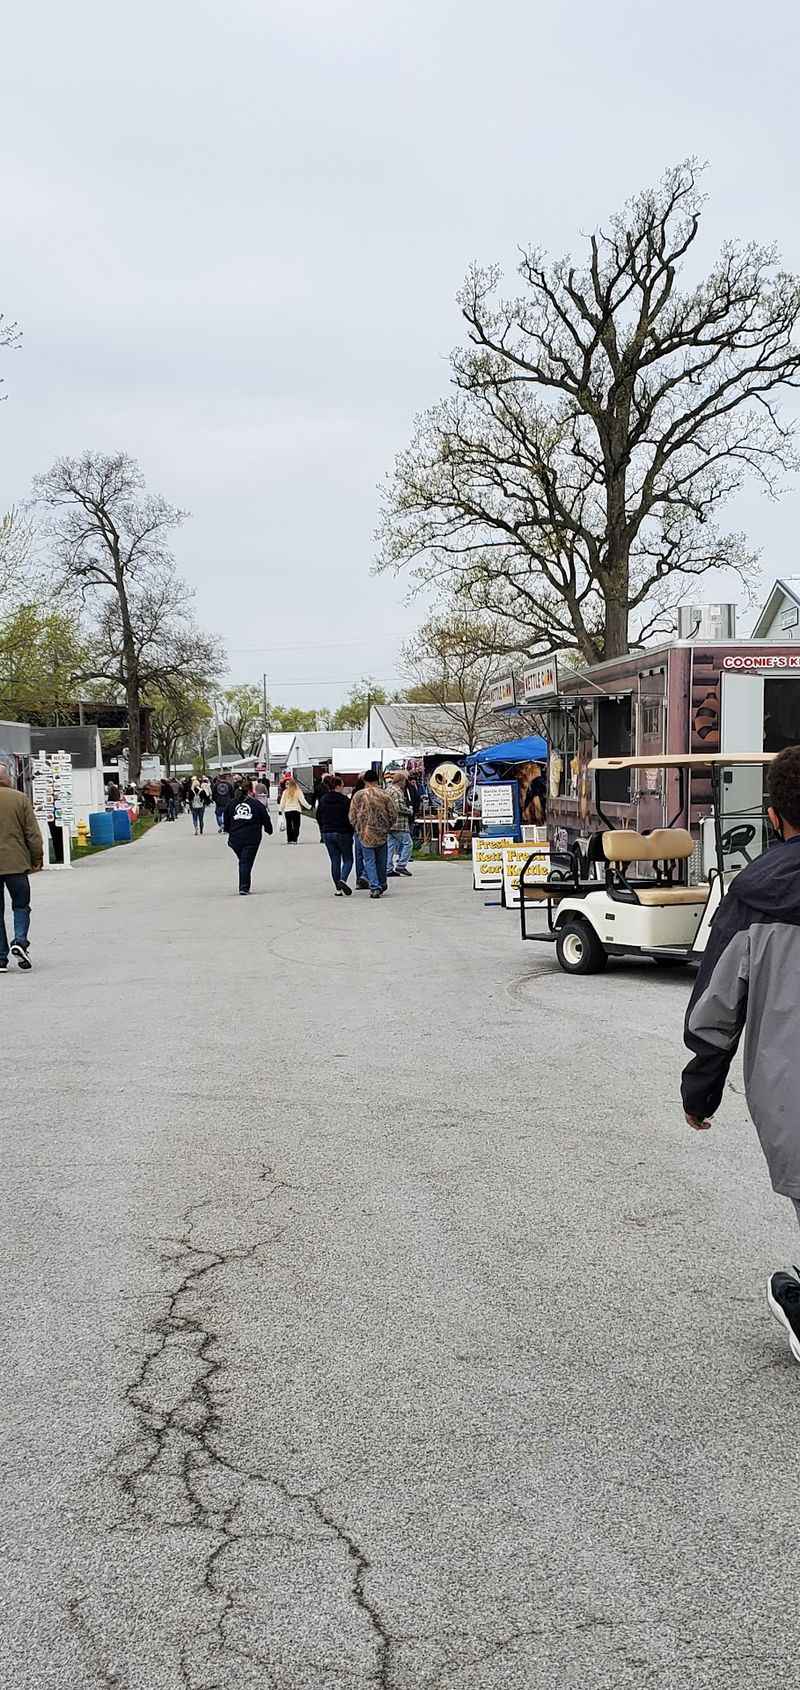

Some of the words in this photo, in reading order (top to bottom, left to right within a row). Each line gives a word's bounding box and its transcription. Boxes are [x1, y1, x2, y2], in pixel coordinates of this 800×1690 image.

[724, 657, 787, 668] COONIE'S
[525, 672, 542, 691] KETTLE
[476, 839, 510, 849] Fresh
[476, 851, 502, 862] Kett
[507, 849, 546, 862] Freh
[480, 865, 501, 874] Cor
